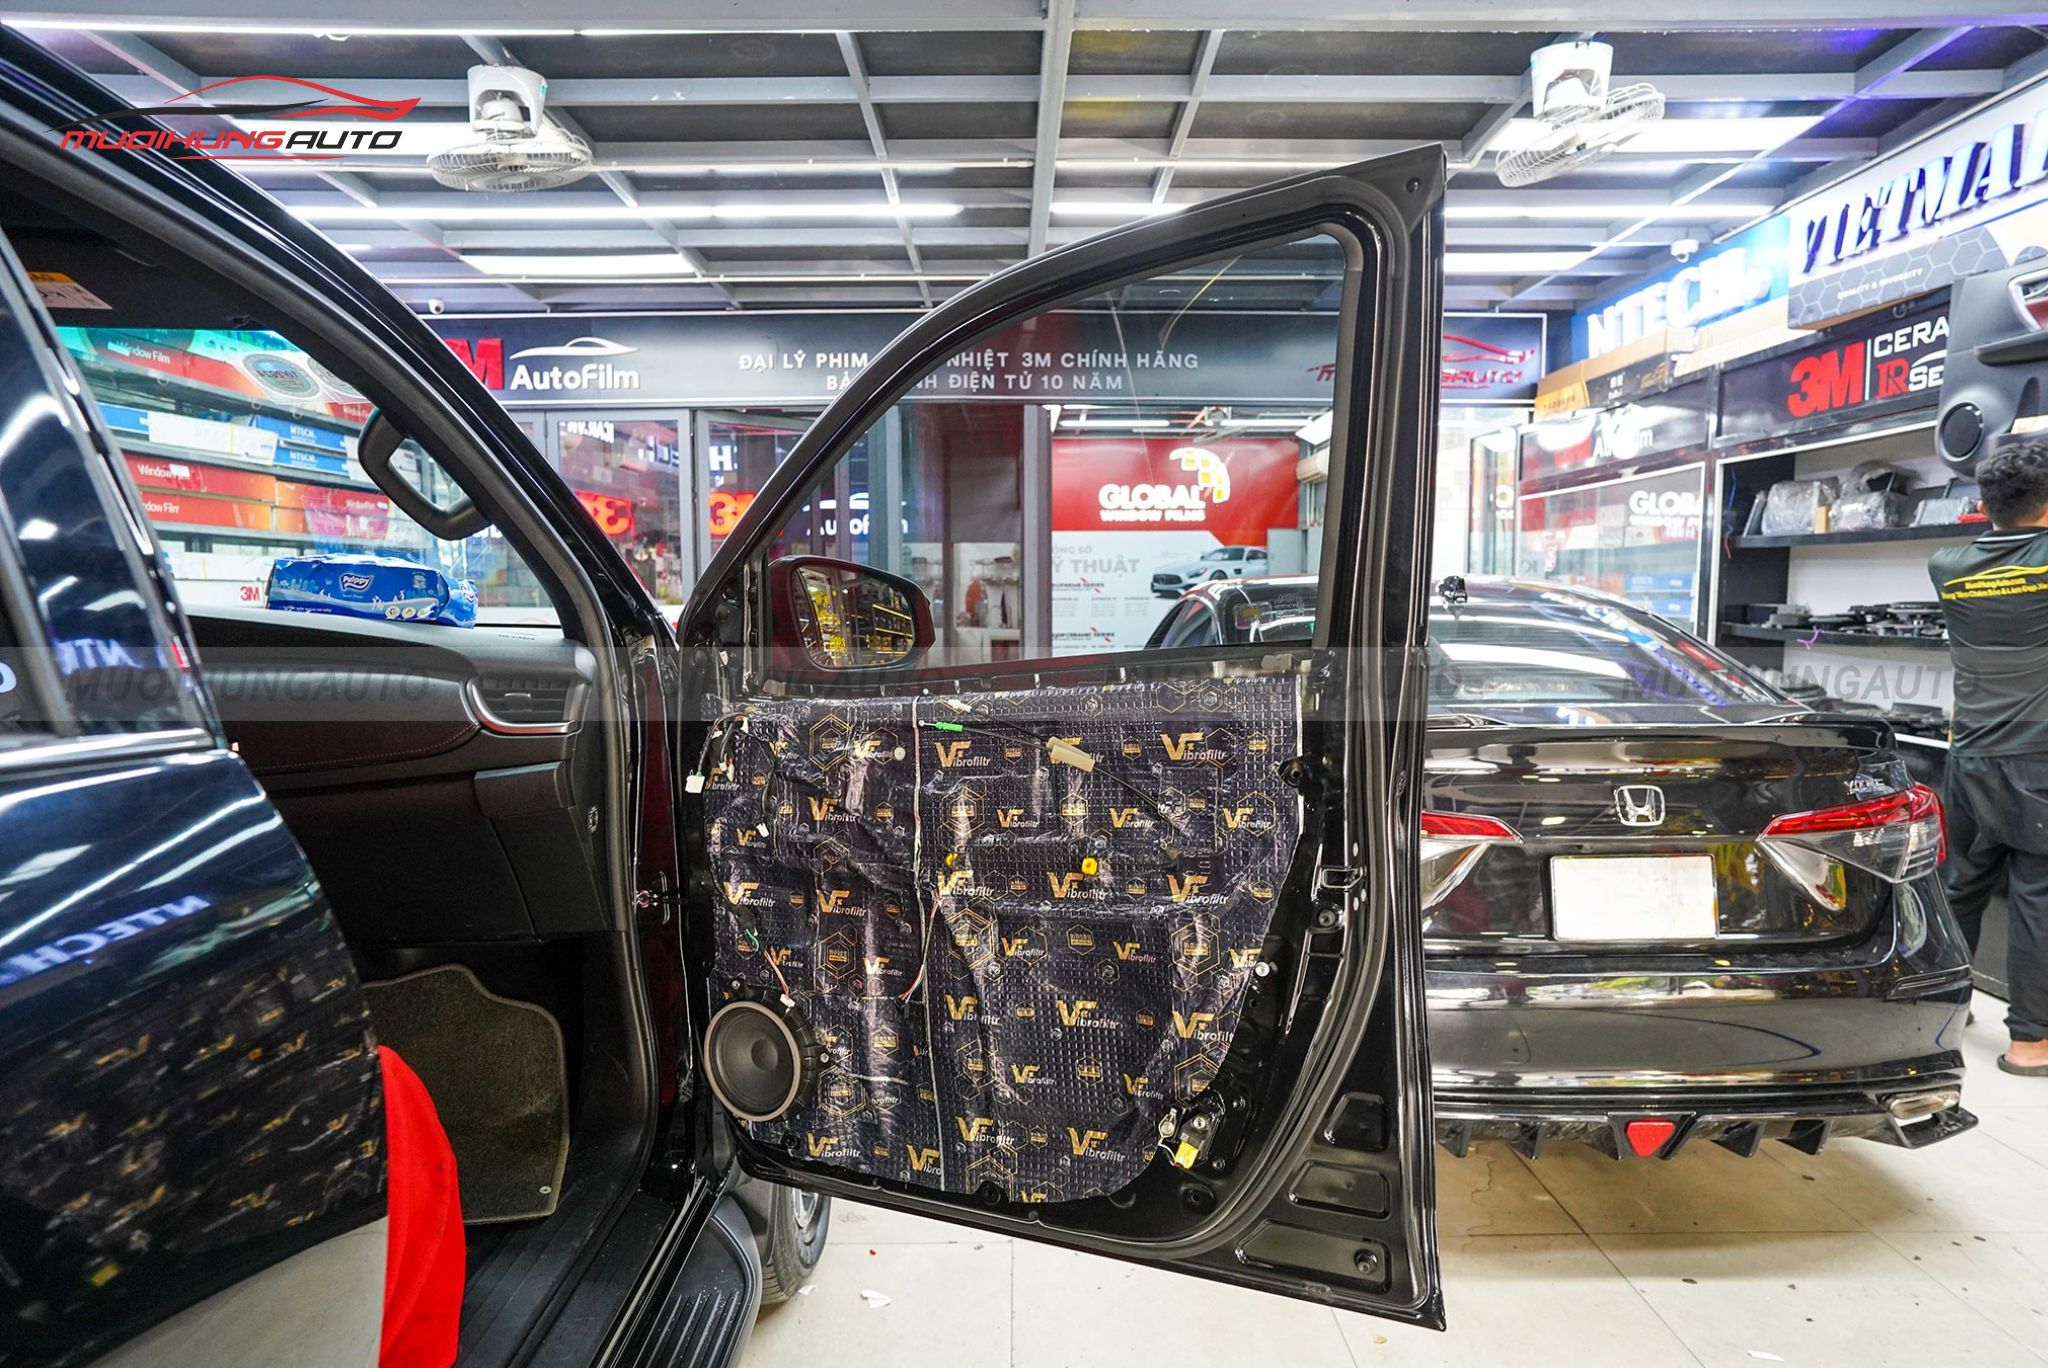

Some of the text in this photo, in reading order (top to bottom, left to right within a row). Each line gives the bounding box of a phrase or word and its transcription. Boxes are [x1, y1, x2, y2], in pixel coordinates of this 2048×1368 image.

[444, 338, 640, 391] M AutoFilm
[739, 352, 773, 372] ĐẠI
[816, 352, 868, 369] PHIM
[947, 349, 1009, 371] NHIỆT
[1021, 352, 1051, 369] 3M
[1060, 349, 1128, 369] CHÍNH
[1137, 350, 1198, 369] HÃNG
[1787, 316, 1950, 418] 3M CERA
[827, 371, 851, 391] BẢ
[949, 373, 995, 393] ĐIỆN
[1004, 370, 1033, 390] TỬ
[1041, 375, 1063, 389] 10
[1072, 373, 1123, 390] NĂM
[1099, 483, 1206, 510] GLOBAL
[240, 586, 260, 602] 3M
